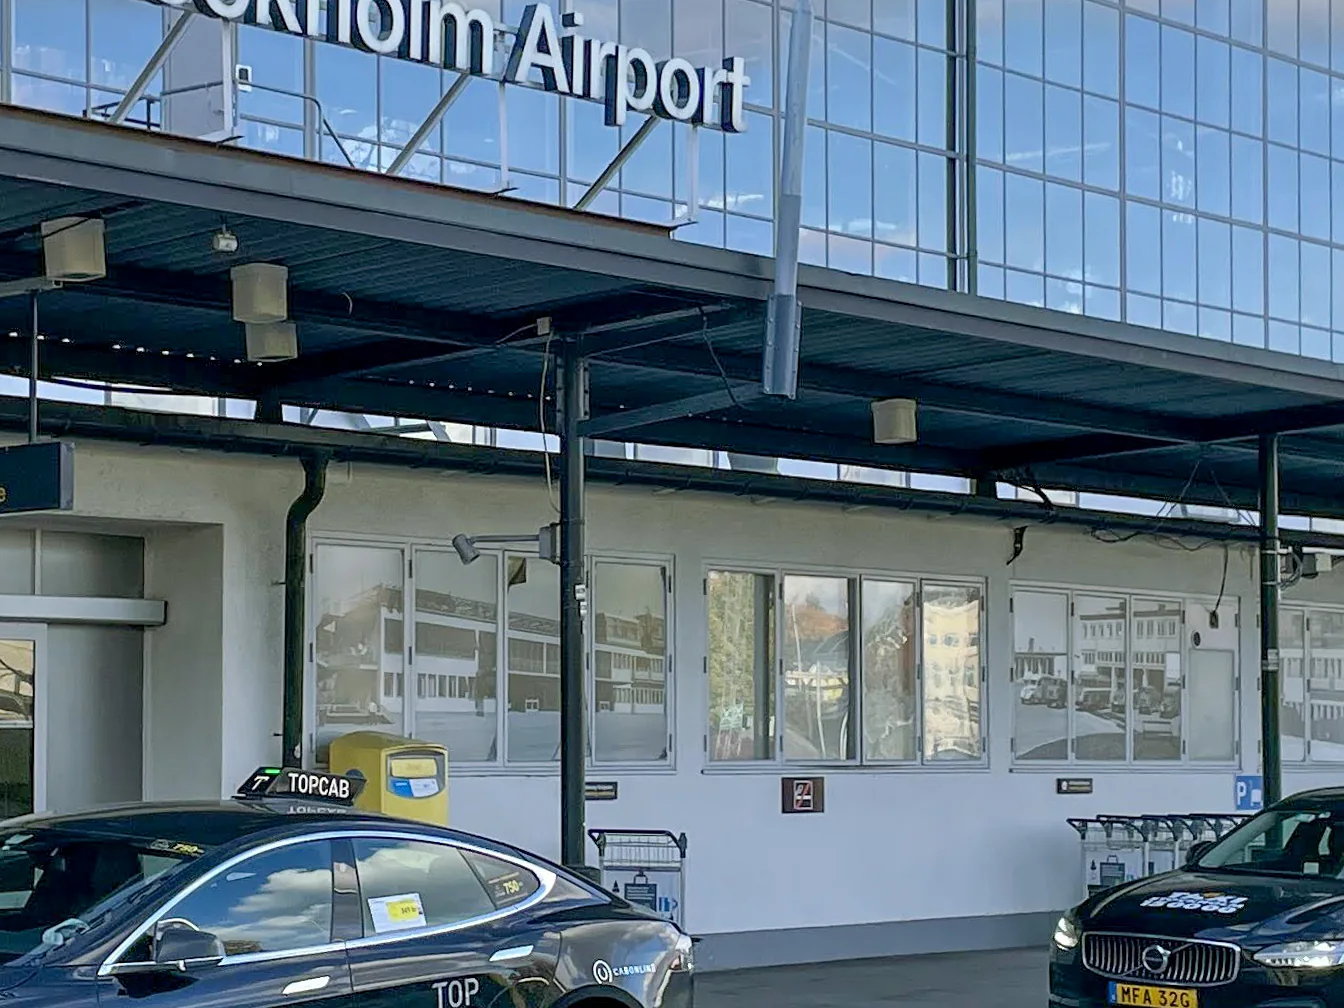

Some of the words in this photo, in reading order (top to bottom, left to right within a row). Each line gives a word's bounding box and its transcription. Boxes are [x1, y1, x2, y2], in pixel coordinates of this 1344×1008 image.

[506, 2, 752, 133] Airport
[288, 772, 350, 799] TOPCAB
[1237, 781, 1247, 806] P
[431, 978, 479, 1008] TOP
[1121, 986, 1152, 1004] MFA
[1158, 989, 1191, 1008] 32G
